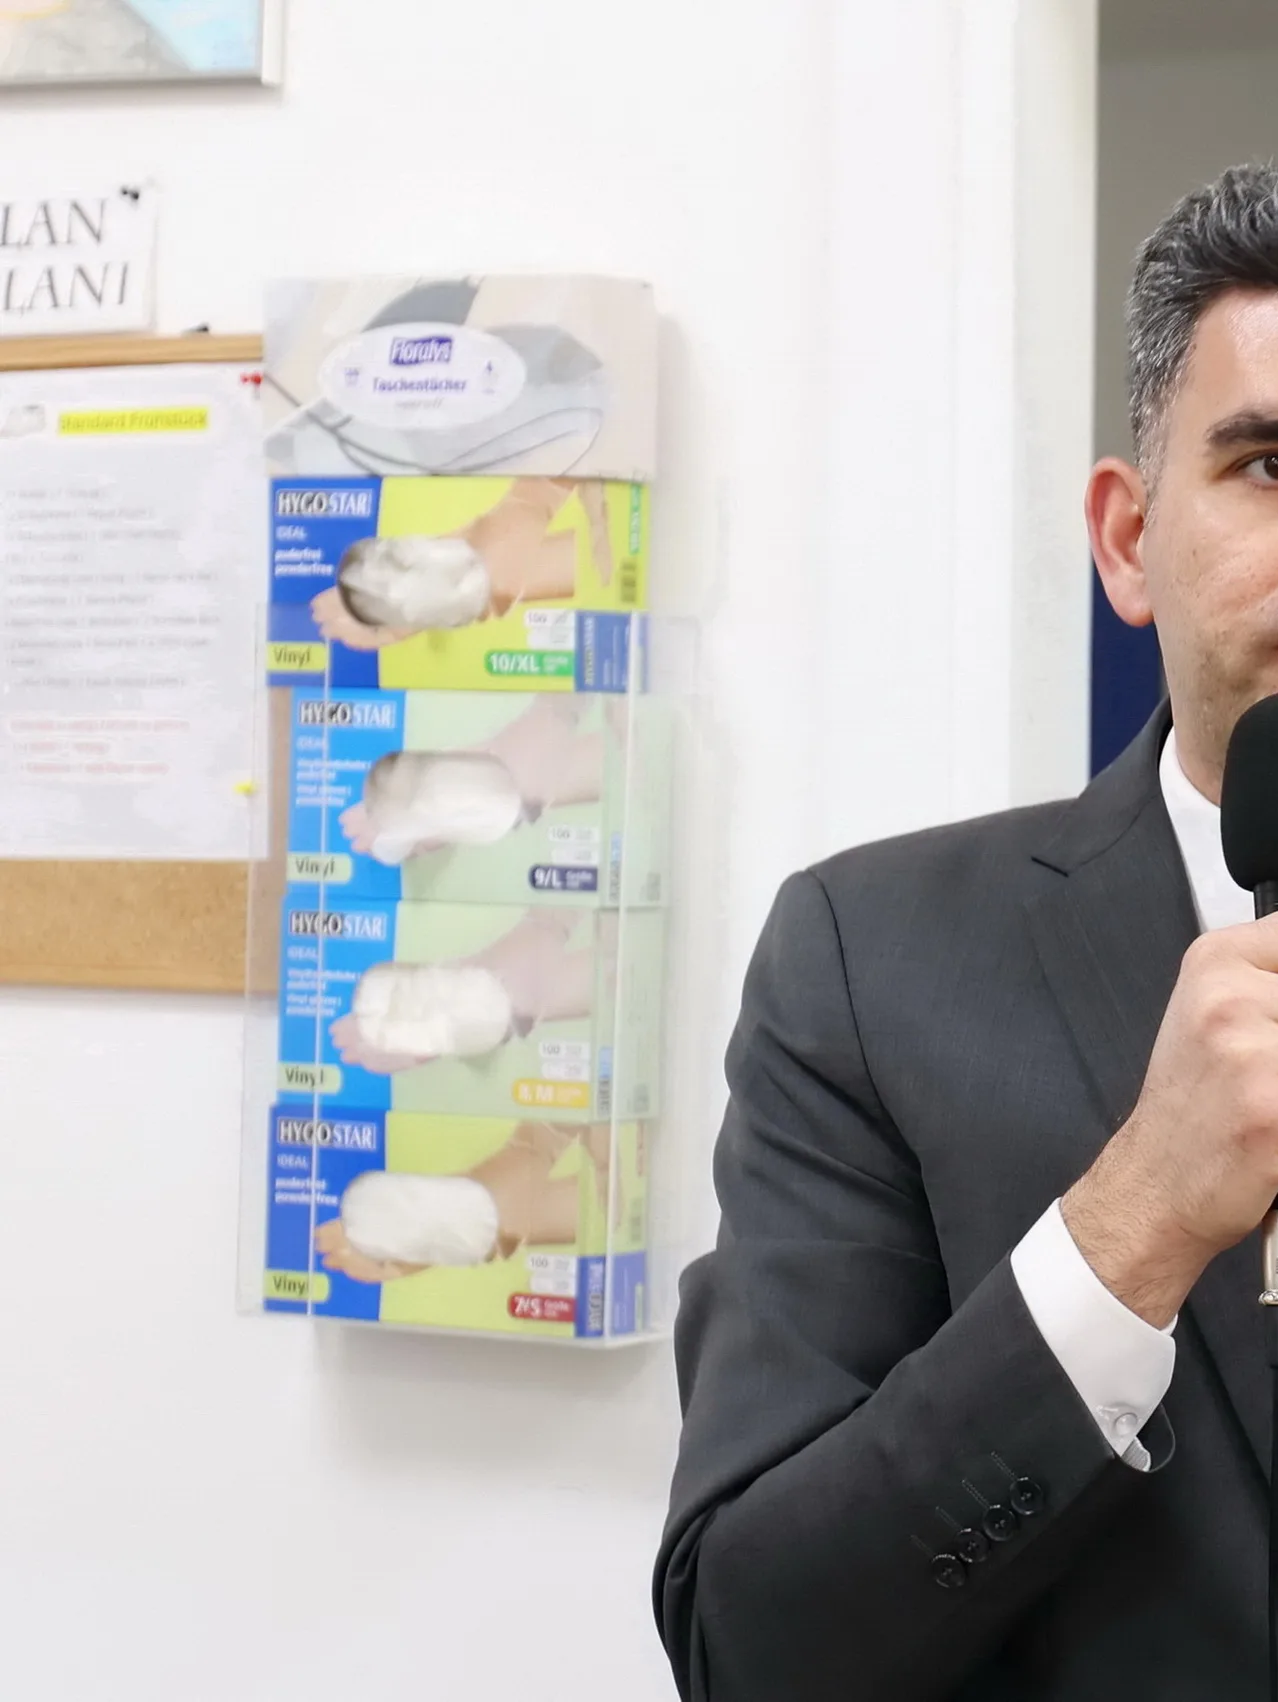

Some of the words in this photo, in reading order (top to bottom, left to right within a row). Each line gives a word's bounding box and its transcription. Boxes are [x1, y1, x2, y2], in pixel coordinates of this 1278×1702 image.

[274, 647, 312, 667] Vinyl
[490, 653, 540, 673] 10/XL
[533, 869, 563, 888] 9/L
[530, 1257, 548, 1268] 100
